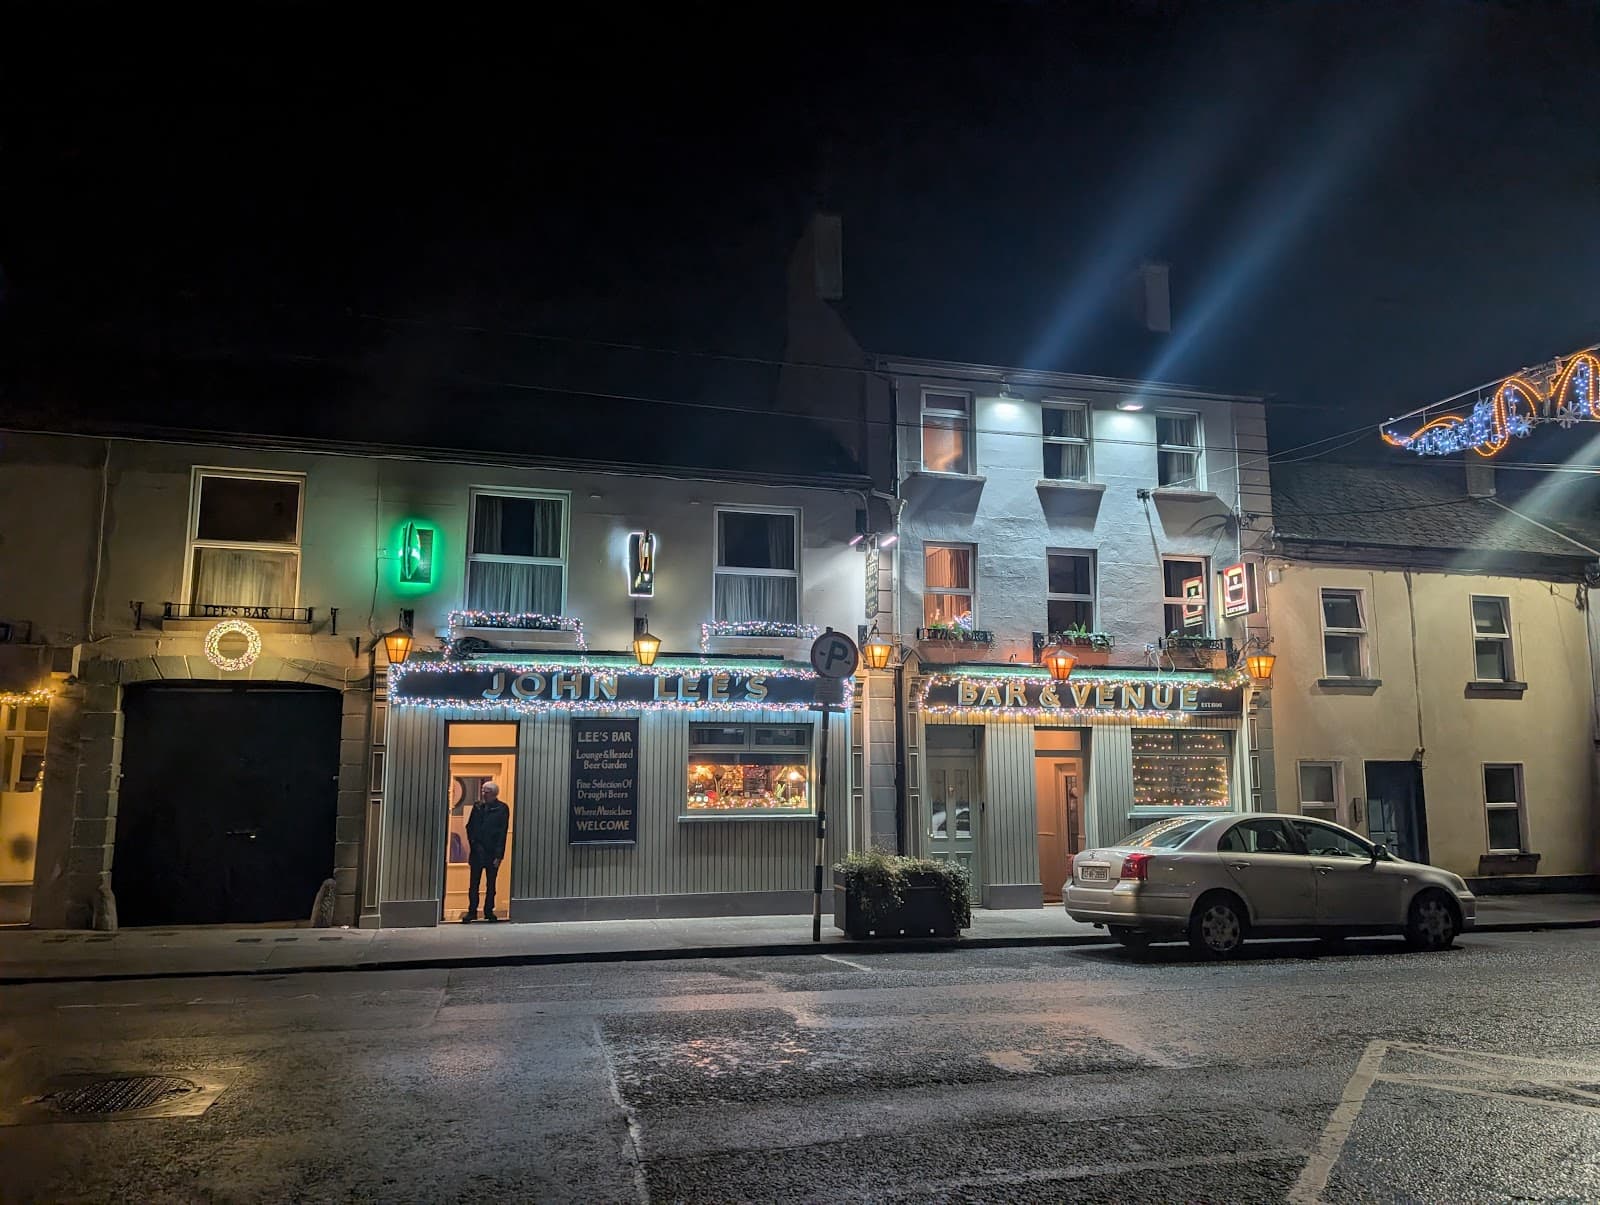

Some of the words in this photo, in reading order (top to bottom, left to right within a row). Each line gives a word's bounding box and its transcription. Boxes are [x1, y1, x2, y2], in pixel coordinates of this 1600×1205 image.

[244, 606, 269, 618] BAR
[482, 672, 619, 701] JOHN
[653, 673, 768, 702] LEE'S
[957, 682, 1028, 707] BAR
[1039, 685, 1062, 709] &
[1070, 683, 1200, 711] VENUE
[577, 731, 609, 743] LEE'S
[611, 731, 632, 742] BAR
[583, 760, 601, 770] Beer
[601, 759, 628, 769] Garden
[576, 820, 630, 831] WELCOME
